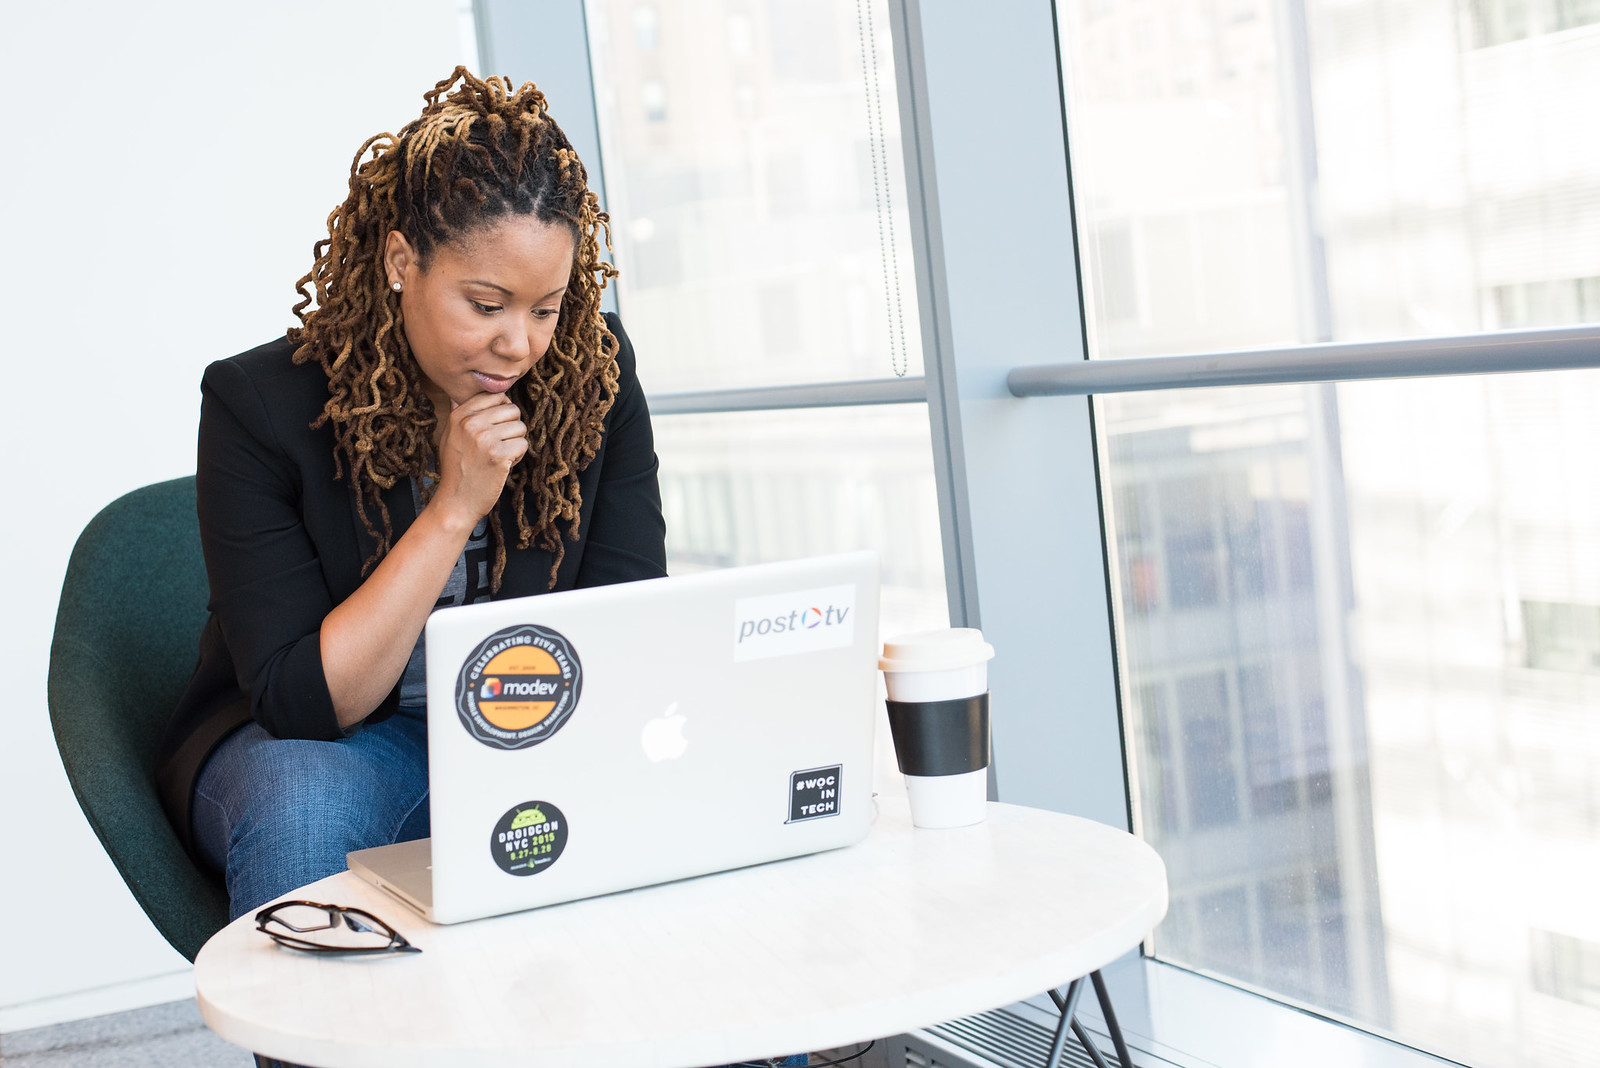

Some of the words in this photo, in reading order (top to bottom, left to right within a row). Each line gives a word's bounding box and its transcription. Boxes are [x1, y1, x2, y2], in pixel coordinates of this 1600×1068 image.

[738, 610, 798, 643] post
[825, 605, 850, 626] tv
[470, 635, 532, 680] CELEBRATING
[533, 636, 556, 653] FIVE
[554, 648, 572, 680] YEARS
[503, 679, 558, 695] modev
[796, 776, 835, 791] #WOC
[821, 789, 835, 799] IN
[801, 801, 834, 815] TECH
[498, 820, 559, 843] DROIDCON
[505, 838, 528, 852] NYC
[532, 832, 555, 846] 2015
